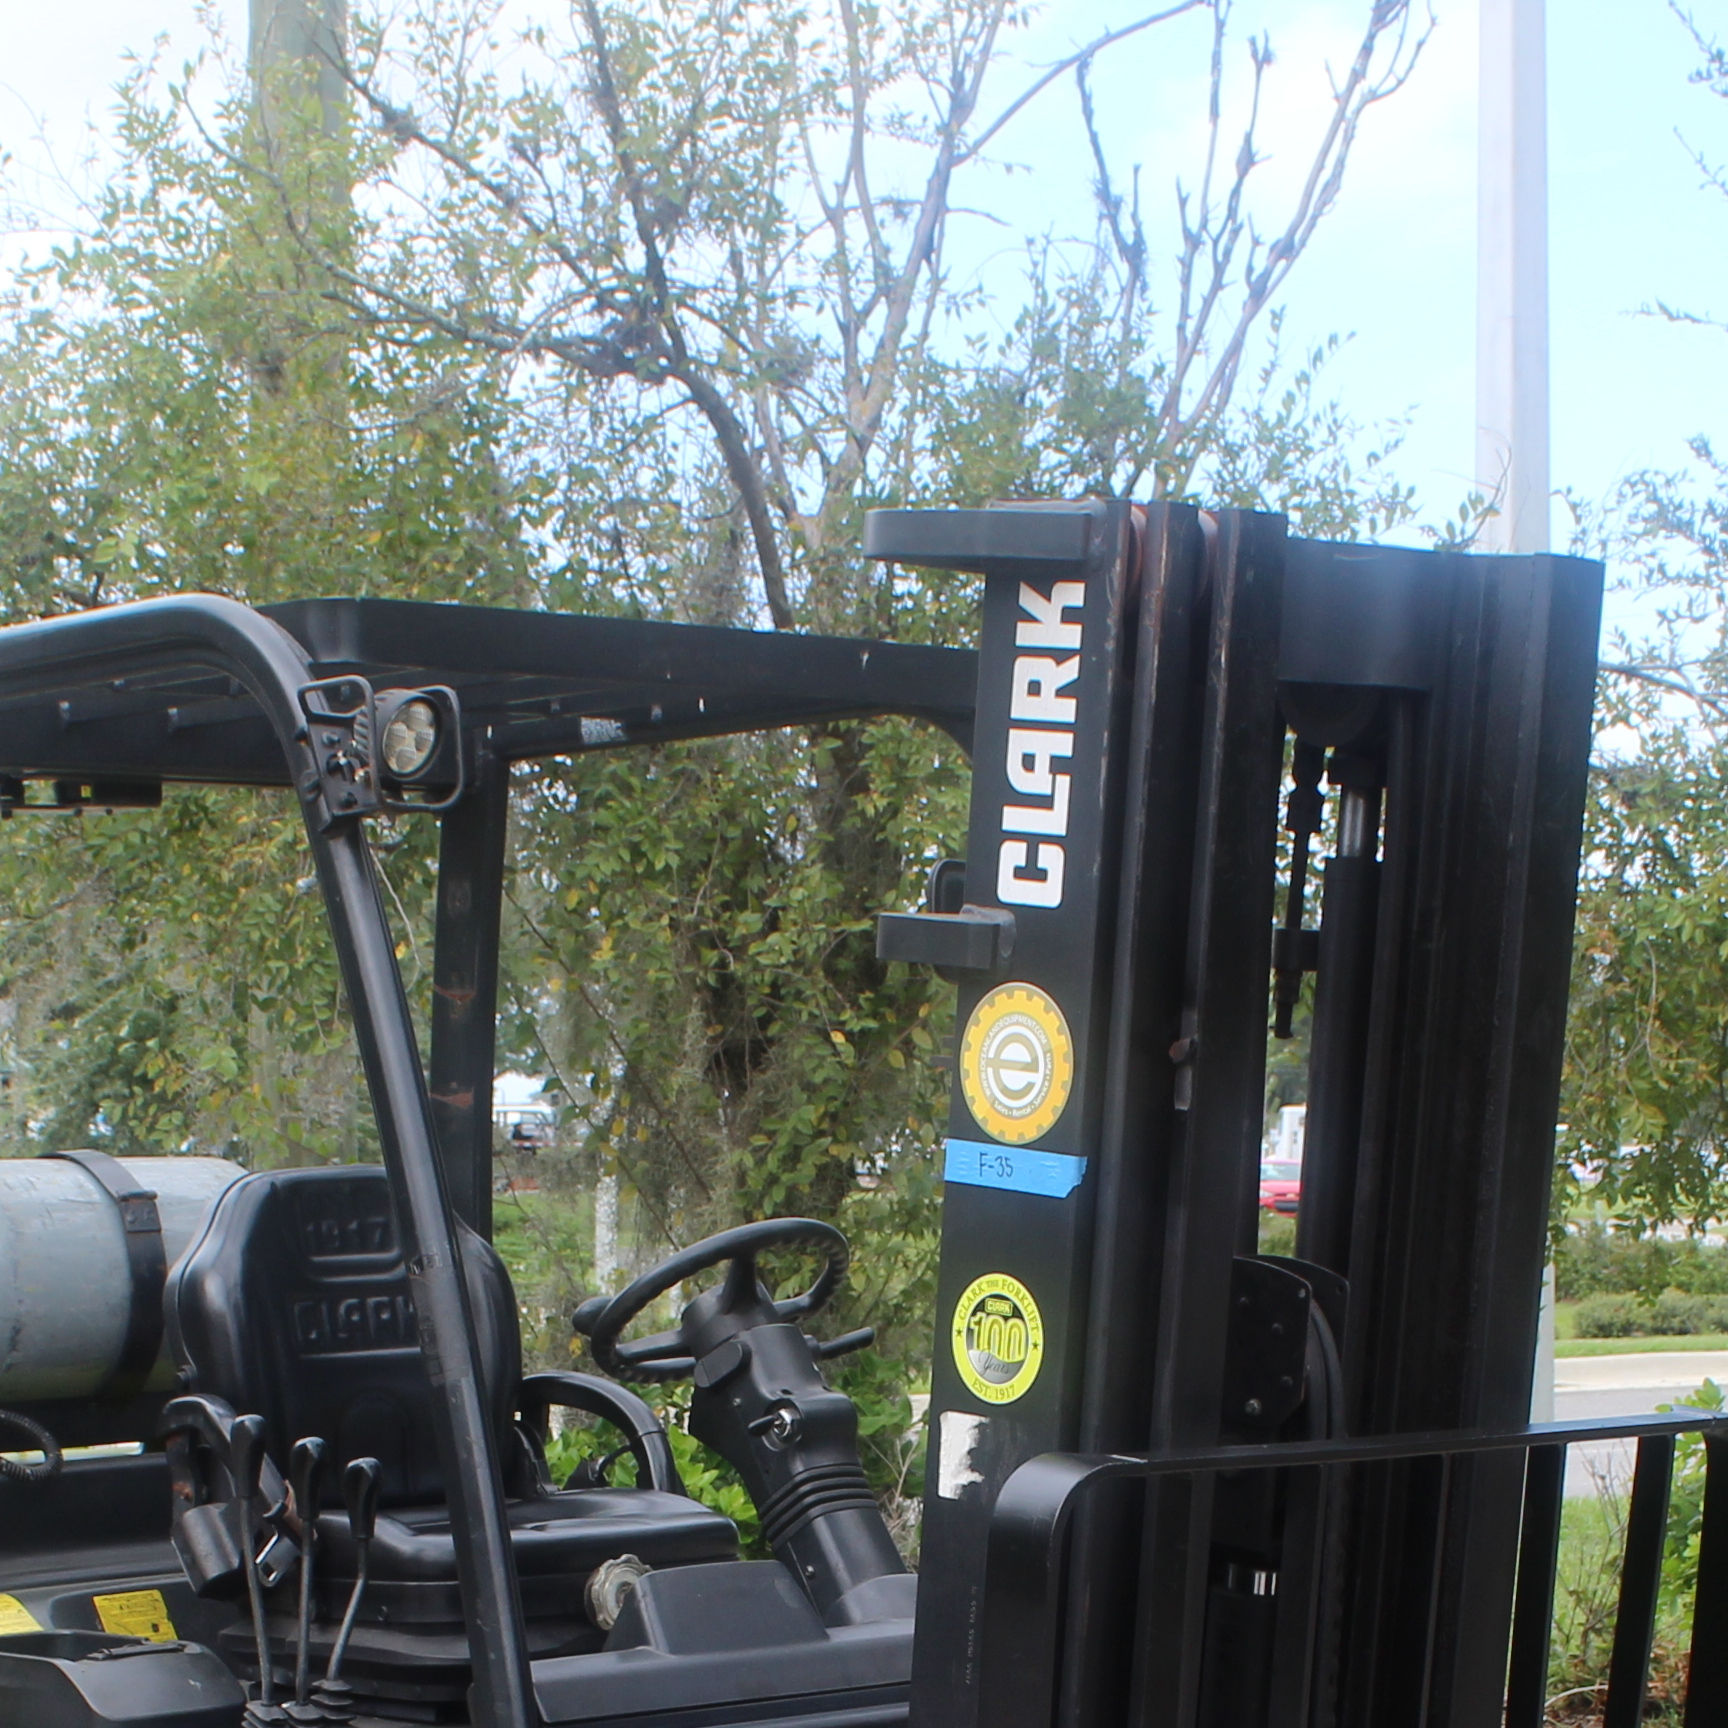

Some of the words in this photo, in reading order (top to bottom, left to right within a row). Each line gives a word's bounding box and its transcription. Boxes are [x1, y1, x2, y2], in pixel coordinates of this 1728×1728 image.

[996, 580, 1087, 909] CLARK
[993, 1100, 1008, 1115] Sales
[1012, 1105, 1032, 1117] Rental
[1033, 1081, 1050, 1107] Service
[979, 1151, 1014, 1178] F-35
[958, 1283, 985, 1320] CLARK
[986, 1279, 1000, 1288] THE
[1001, 1279, 1040, 1333] FORKLIFT
[970, 1311, 1027, 1362] 100
[978, 1349, 1010, 1376] Years
[972, 1378, 992, 1400] EST.
[994, 1384, 1016, 1400] 1917
